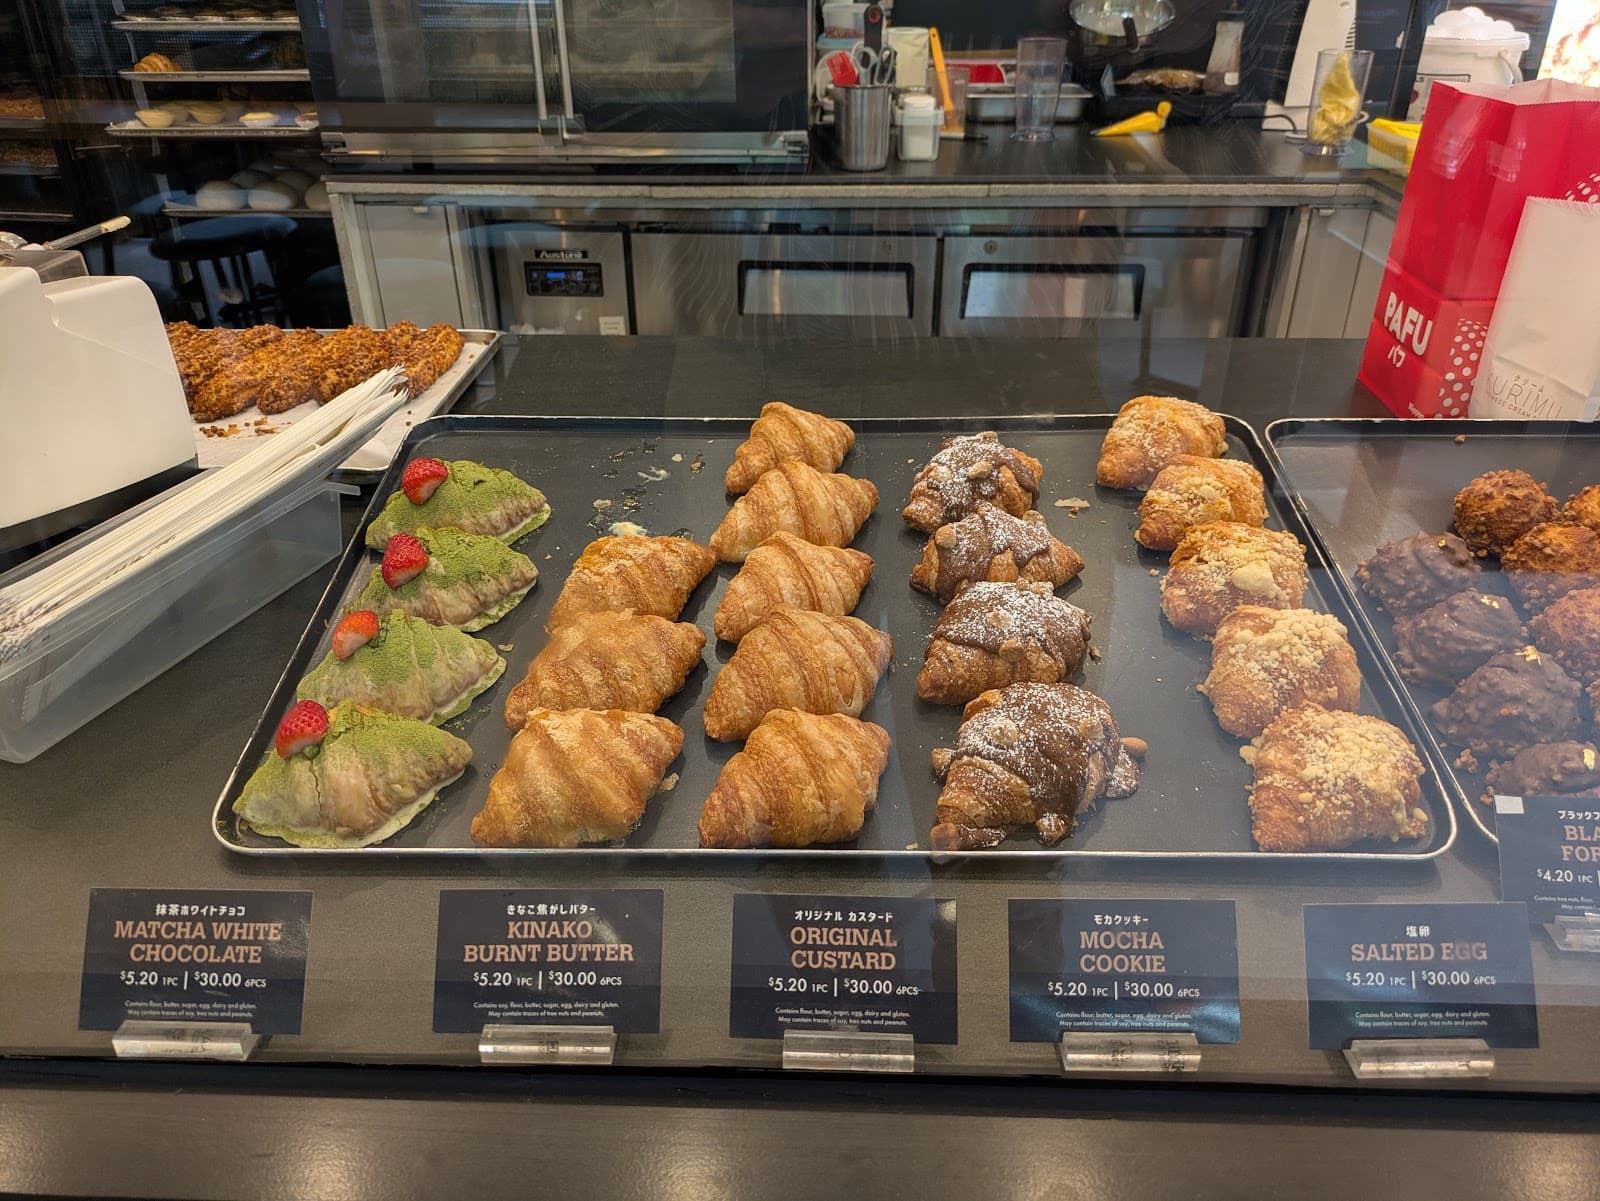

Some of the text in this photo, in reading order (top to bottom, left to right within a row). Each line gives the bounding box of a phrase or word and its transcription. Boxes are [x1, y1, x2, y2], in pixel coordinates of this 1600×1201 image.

[1384, 291, 1432, 355] PAFU
[1537, 869, 1593, 883] $4.20 1PC
[156, 904, 246, 916] 抹茶ホワイトチョコ
[506, 904, 596, 916] きなこ焦がしバター
[794, 910, 893, 923] オリジナル カスタード
[1094, 914, 1149, 925] モカクッキー
[114, 920, 282, 940] MATCHA WHITE
[507, 920, 592, 939] KINAKO
[790, 926, 897, 947] ORIGINAL
[1406, 925, 1430, 937] 塩卵
[1080, 931, 1164, 949] MOCHA
[130, 944, 262, 963] CHOCOLATE
[464, 944, 634, 962] BURNT BUTTER
[791, 950, 896, 970] CUSTARD
[1351, 942, 1488, 961] SALTED EGG
[1080, 954, 1166, 972] COOKIE
[120, 970, 266, 988] $5.20 1PC $30.00 6PCS
[473, 970, 622, 986] $5.20 1PC $30.00 6PCS
[768, 976, 918, 995] $5.20 1PC $30.00 6PCS
[1345, 970, 1496, 986] $5.20 1PC $30.00 6PCS
[1048, 981, 1200, 997] $5.20 1PC $30.00 6PCS
